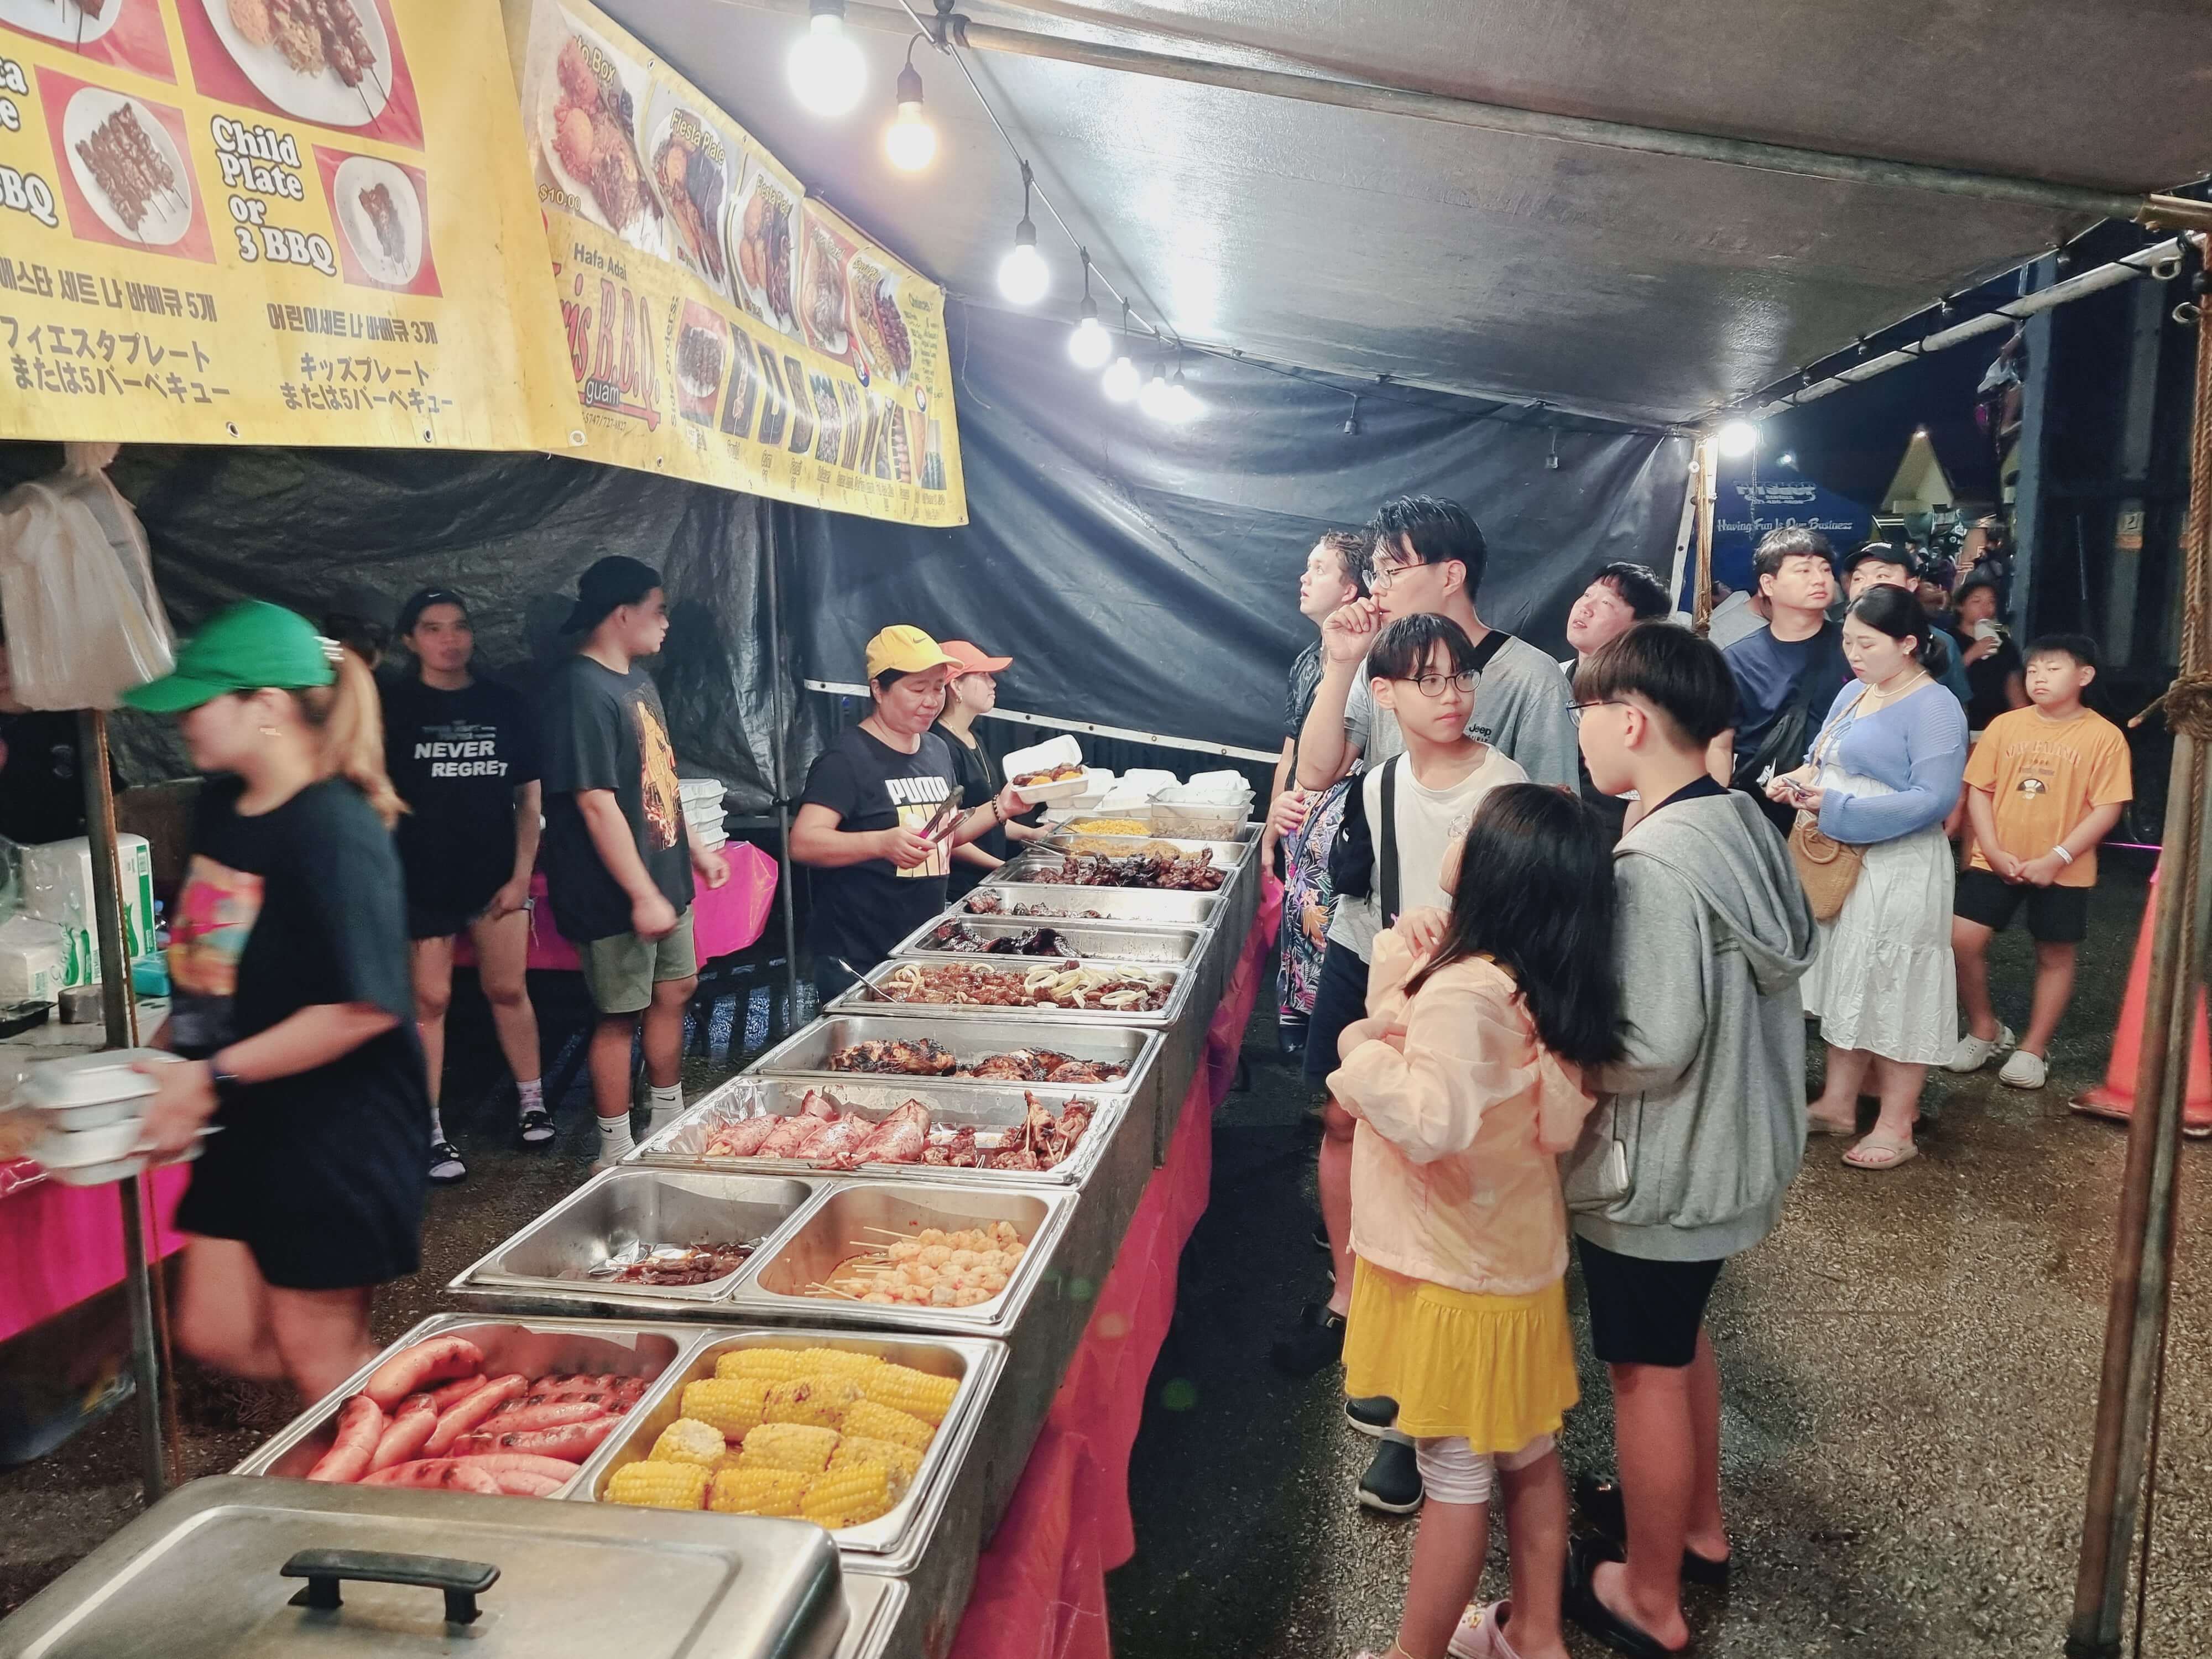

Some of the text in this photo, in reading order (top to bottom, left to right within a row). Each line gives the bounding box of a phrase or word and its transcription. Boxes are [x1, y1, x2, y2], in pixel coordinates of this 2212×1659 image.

[592, 48, 616, 86] Box
[211, 114, 301, 169] Child
[670, 108, 726, 165] Fiesta Plate
[216, 149, 304, 201] Plate
[0, 165, 59, 228] BQ
[228, 194, 267, 226] or
[539, 184, 582, 210] $10.00
[234, 226, 337, 276] 3 BBQ
[573, 242, 627, 281] Hafa Adai
[58, 269, 100, 306] 세트
[100, 277, 123, 309] 나
[125, 281, 183, 317] 바베큐
[185, 291, 218, 322] 5개
[267, 302, 439, 345] 어린이세트 나 바베큐 3개
[10, 353, 231, 404] または5バーベキュー
[300, 352, 430, 387] キッズプレート
[280, 382, 453, 414] または5バーベキュー
[586, 380, 620, 405] guam
[1717, 518, 1752, 533] Having
[1754, 517, 1773, 531] Fun
[1775, 518, 1783, 529] Is
[1808, 517, 1853, 530] Business
[1469, 723, 1492, 737] Jeep
[414, 740, 495, 759] NEVER
[431, 760, 508, 778] REGRET
[885, 776, 951, 806] PUMA
